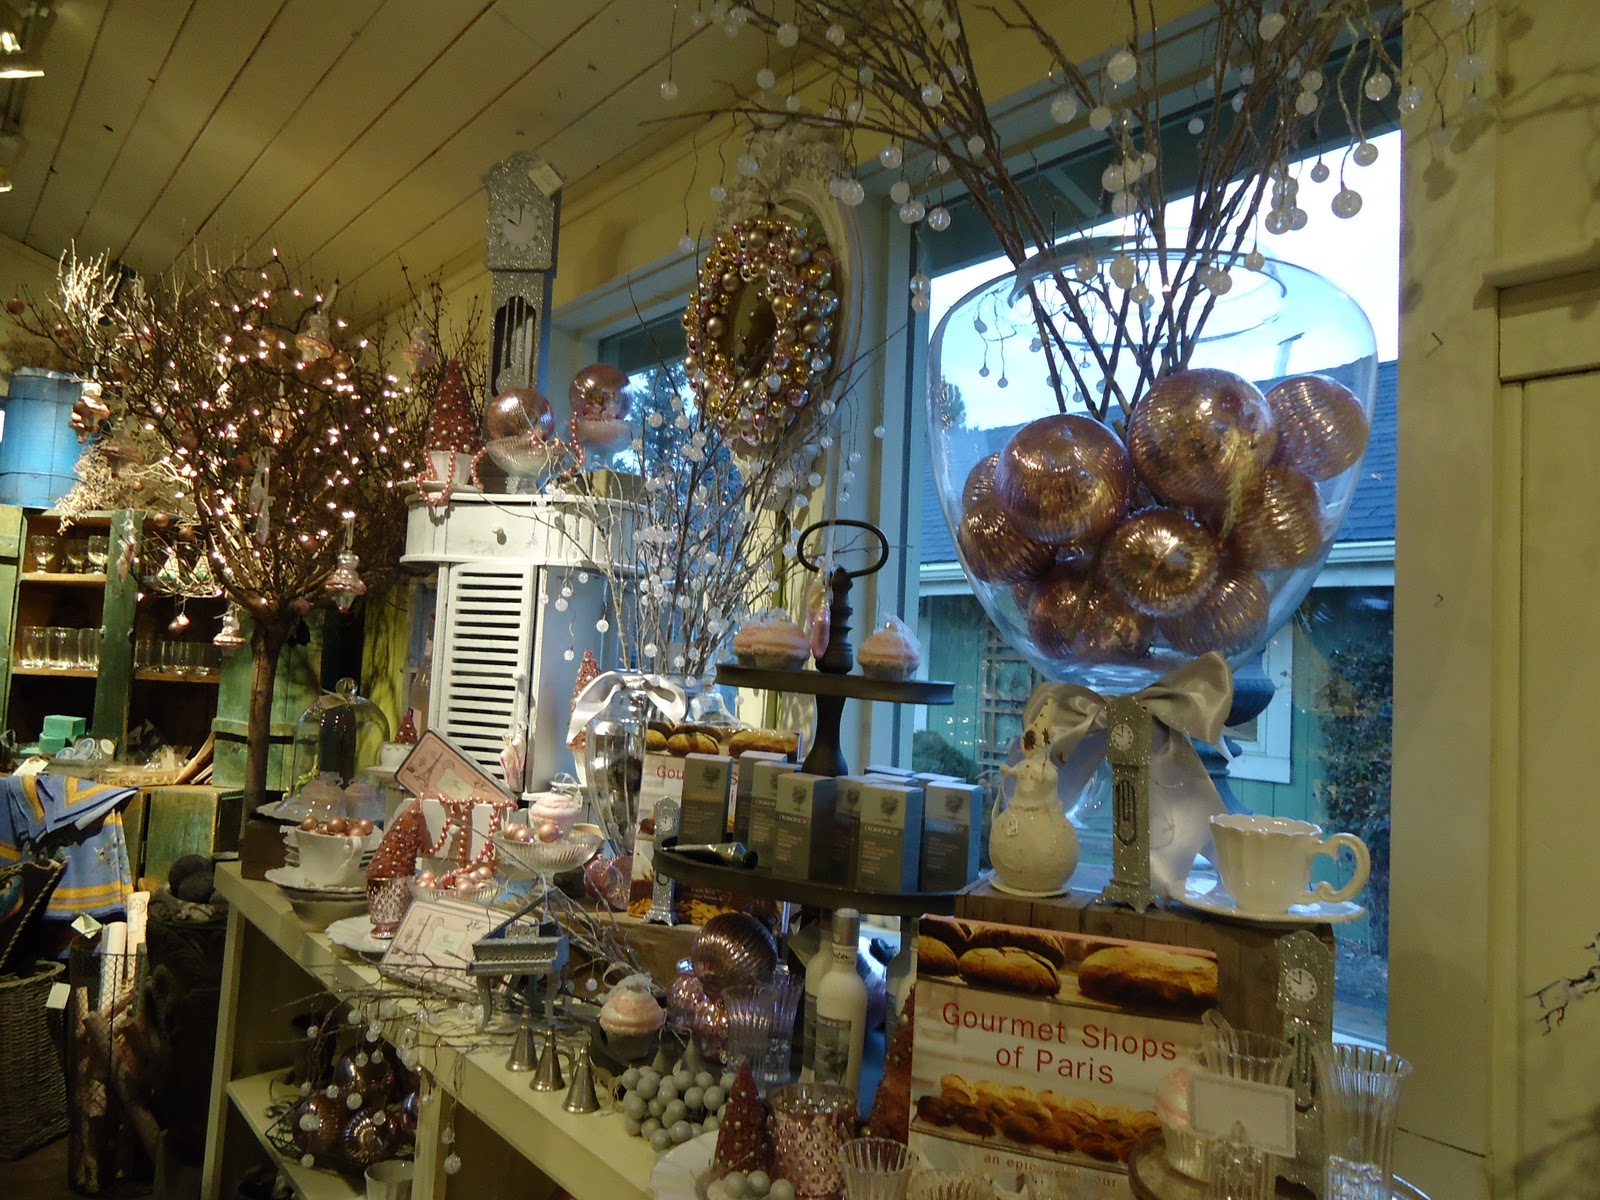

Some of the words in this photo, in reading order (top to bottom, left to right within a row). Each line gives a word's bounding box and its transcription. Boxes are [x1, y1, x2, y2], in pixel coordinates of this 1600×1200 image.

[942, 1001, 1067, 1045] Gourmet
[1081, 1023, 1177, 1062] Shops
[995, 1045, 1024, 1069] of
[1036, 1048, 1115, 1085] Paris
[984, 1153, 1000, 1166] an
